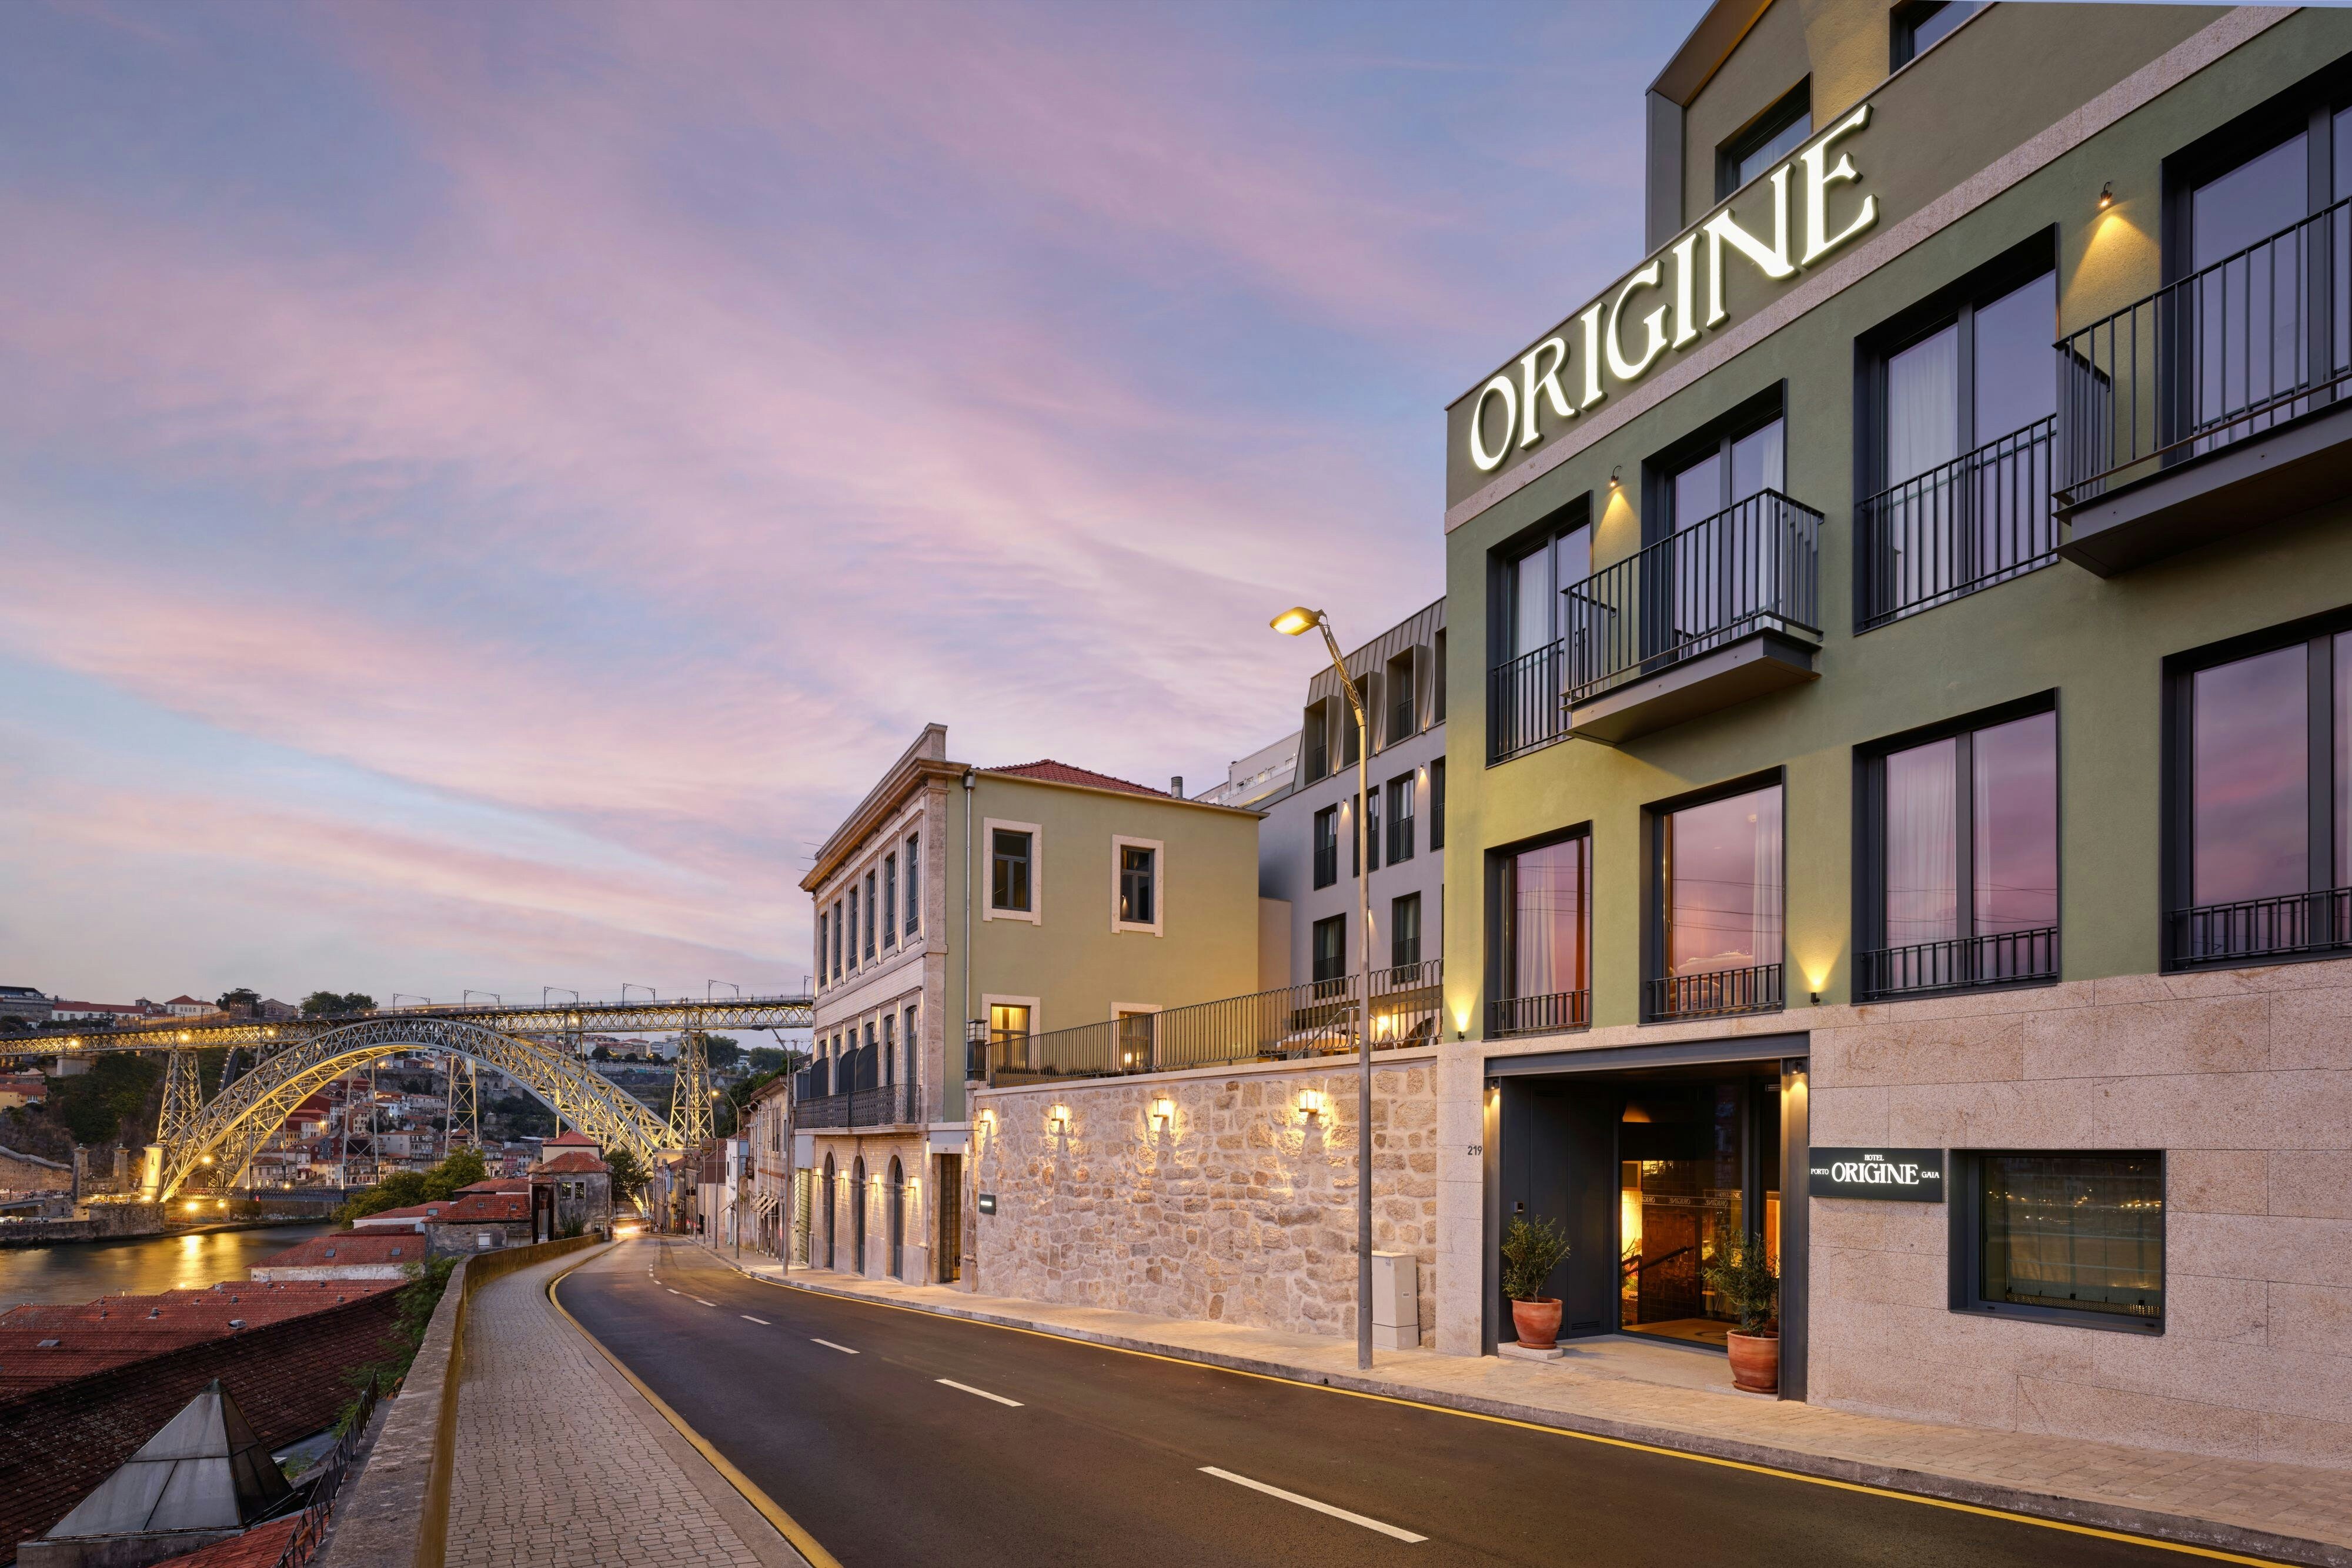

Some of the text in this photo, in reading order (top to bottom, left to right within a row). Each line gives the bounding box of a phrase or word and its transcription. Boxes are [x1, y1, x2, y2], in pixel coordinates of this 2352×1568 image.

[1469, 103, 1879, 472] ORIGINE
[1467, 1145, 1482, 1156] 219
[1831, 1162, 1920, 1185] ORIGINE
